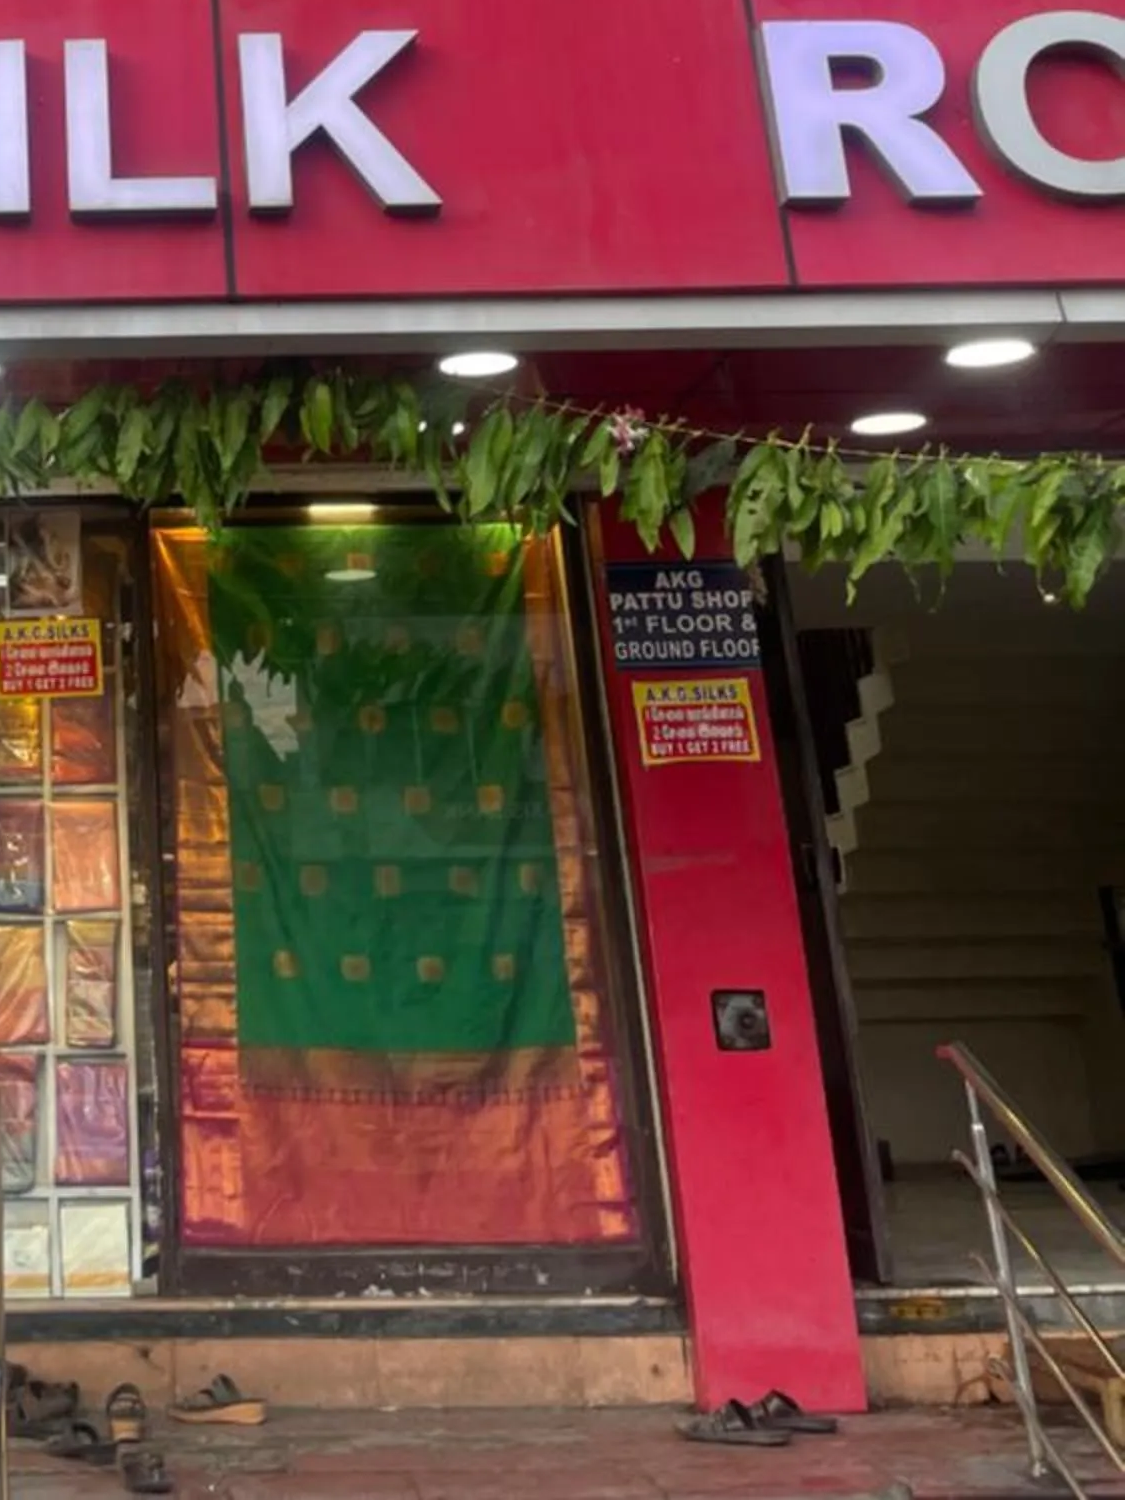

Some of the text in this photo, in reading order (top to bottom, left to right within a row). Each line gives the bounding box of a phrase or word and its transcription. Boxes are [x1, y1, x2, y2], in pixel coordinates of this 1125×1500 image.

[655, 570, 703, 589] AKG
[609, 590, 753, 611] PATTU SHOP
[646, 614, 733, 633] FLOOR
[741, 614, 757, 632] &
[615, 640, 695, 660] GROUND
